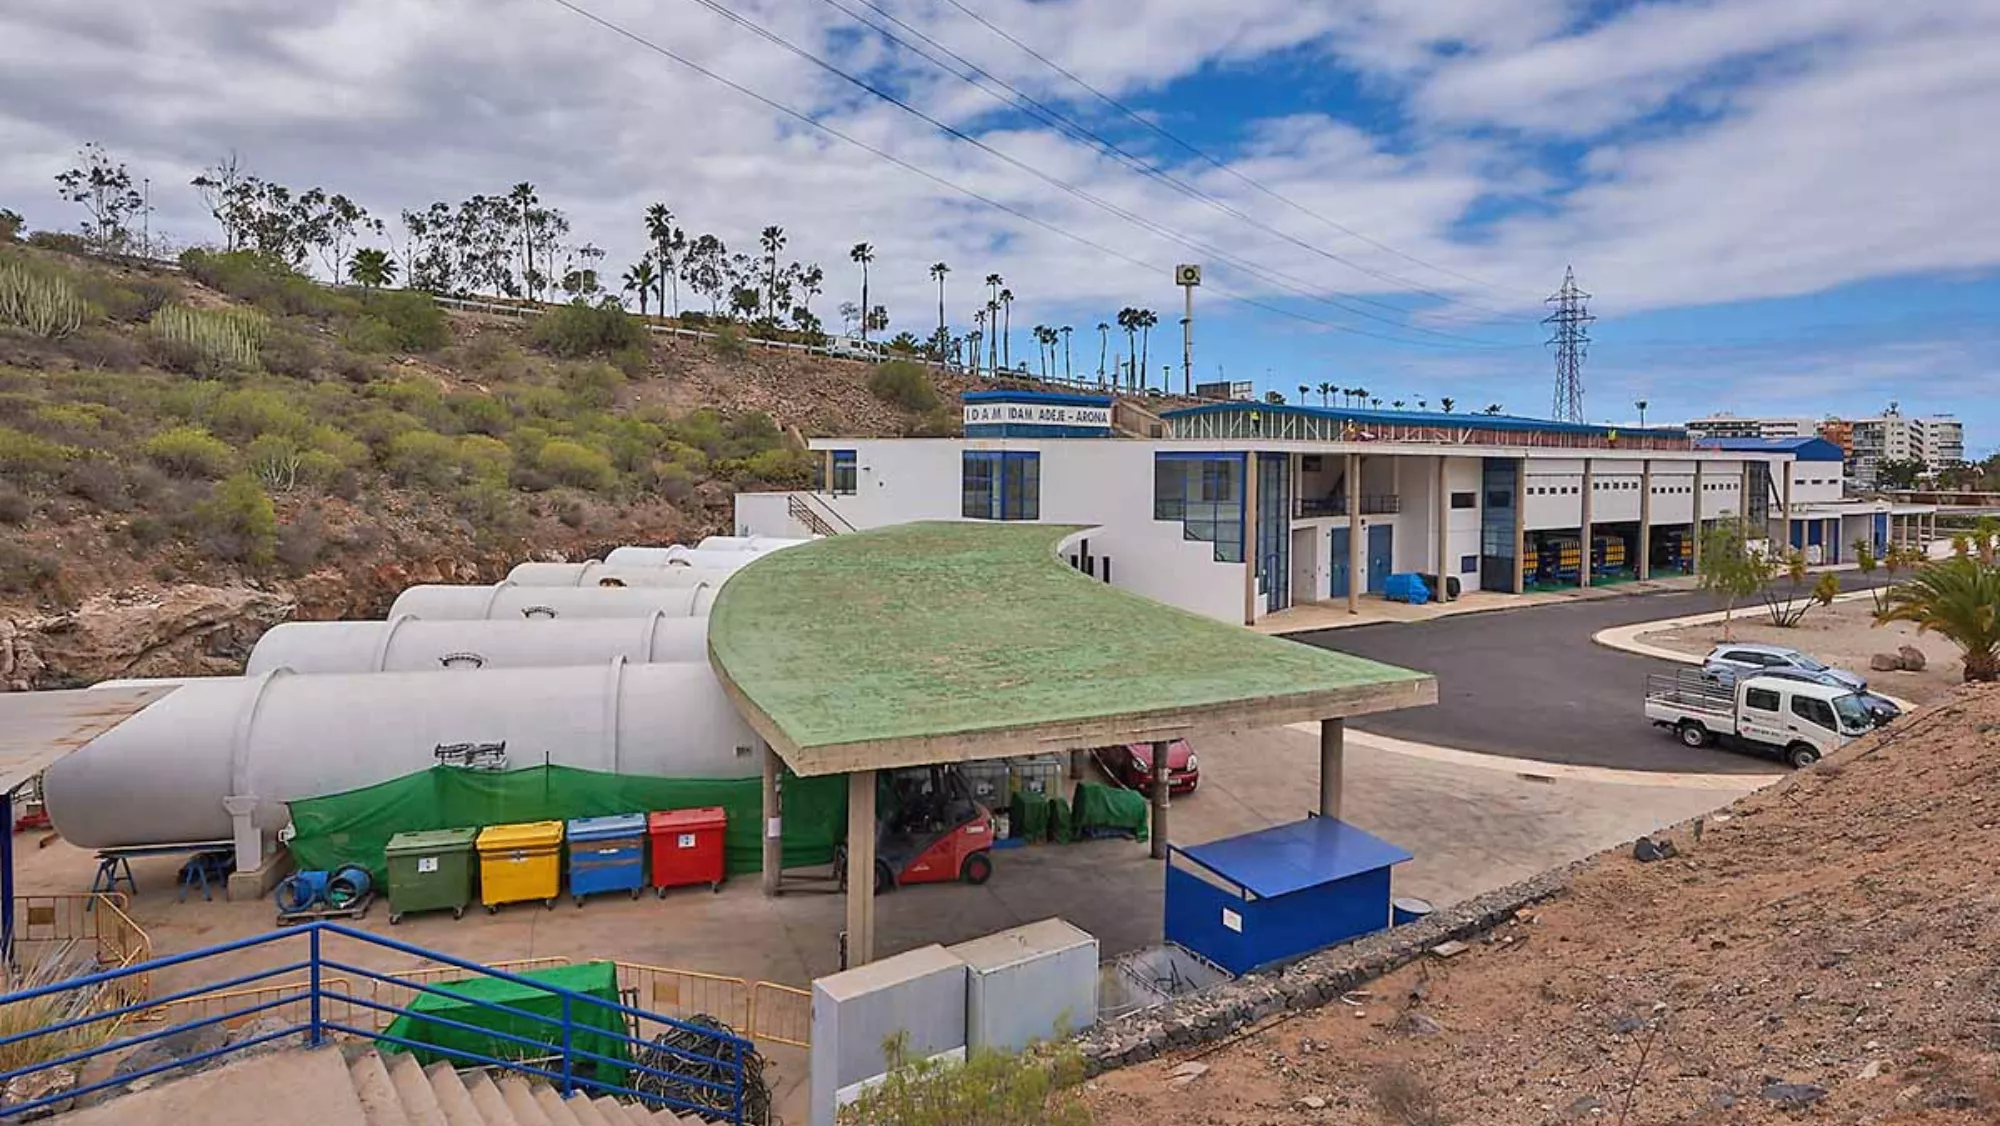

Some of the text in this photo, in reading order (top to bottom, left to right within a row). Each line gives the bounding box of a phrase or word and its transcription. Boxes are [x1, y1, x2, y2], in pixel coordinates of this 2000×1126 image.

[1007, 406, 1033, 420] IDAM
[1038, 407, 1065, 422] ADEJE
[1076, 409, 1108, 423] ARONA
